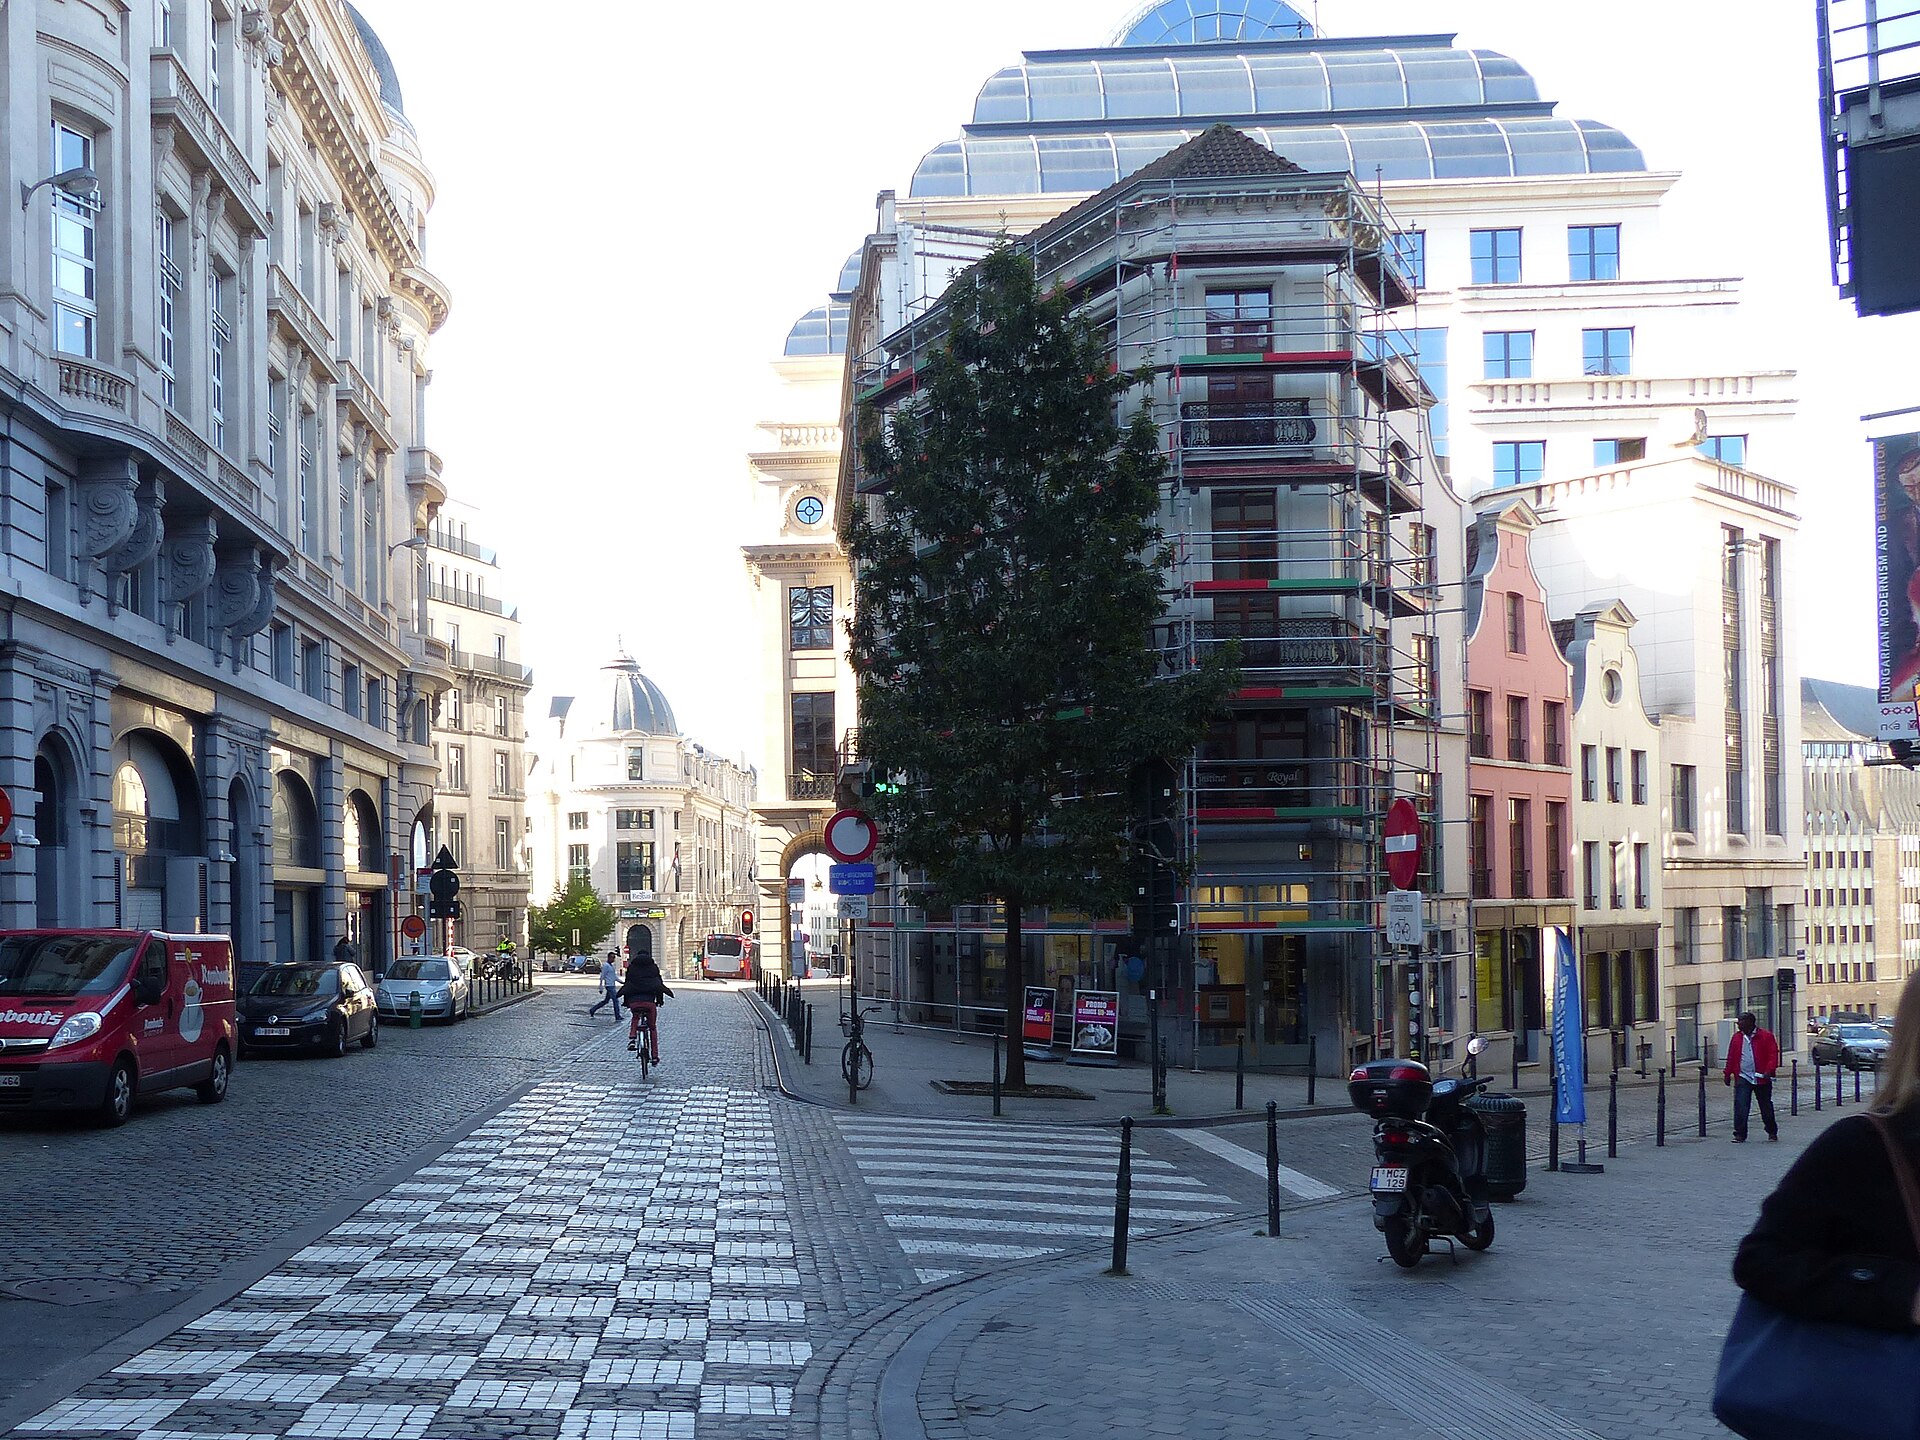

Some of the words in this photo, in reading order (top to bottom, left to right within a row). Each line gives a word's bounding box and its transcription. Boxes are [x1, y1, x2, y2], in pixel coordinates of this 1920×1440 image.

[1877, 526, 1888, 551] AND
[1877, 555, 1889, 627] MODERNISM
[1880, 632, 1891, 702] HUNGARIAN
[1267, 768, 1300, 786] Royal
[1386, 1179, 1405, 1188] 129
